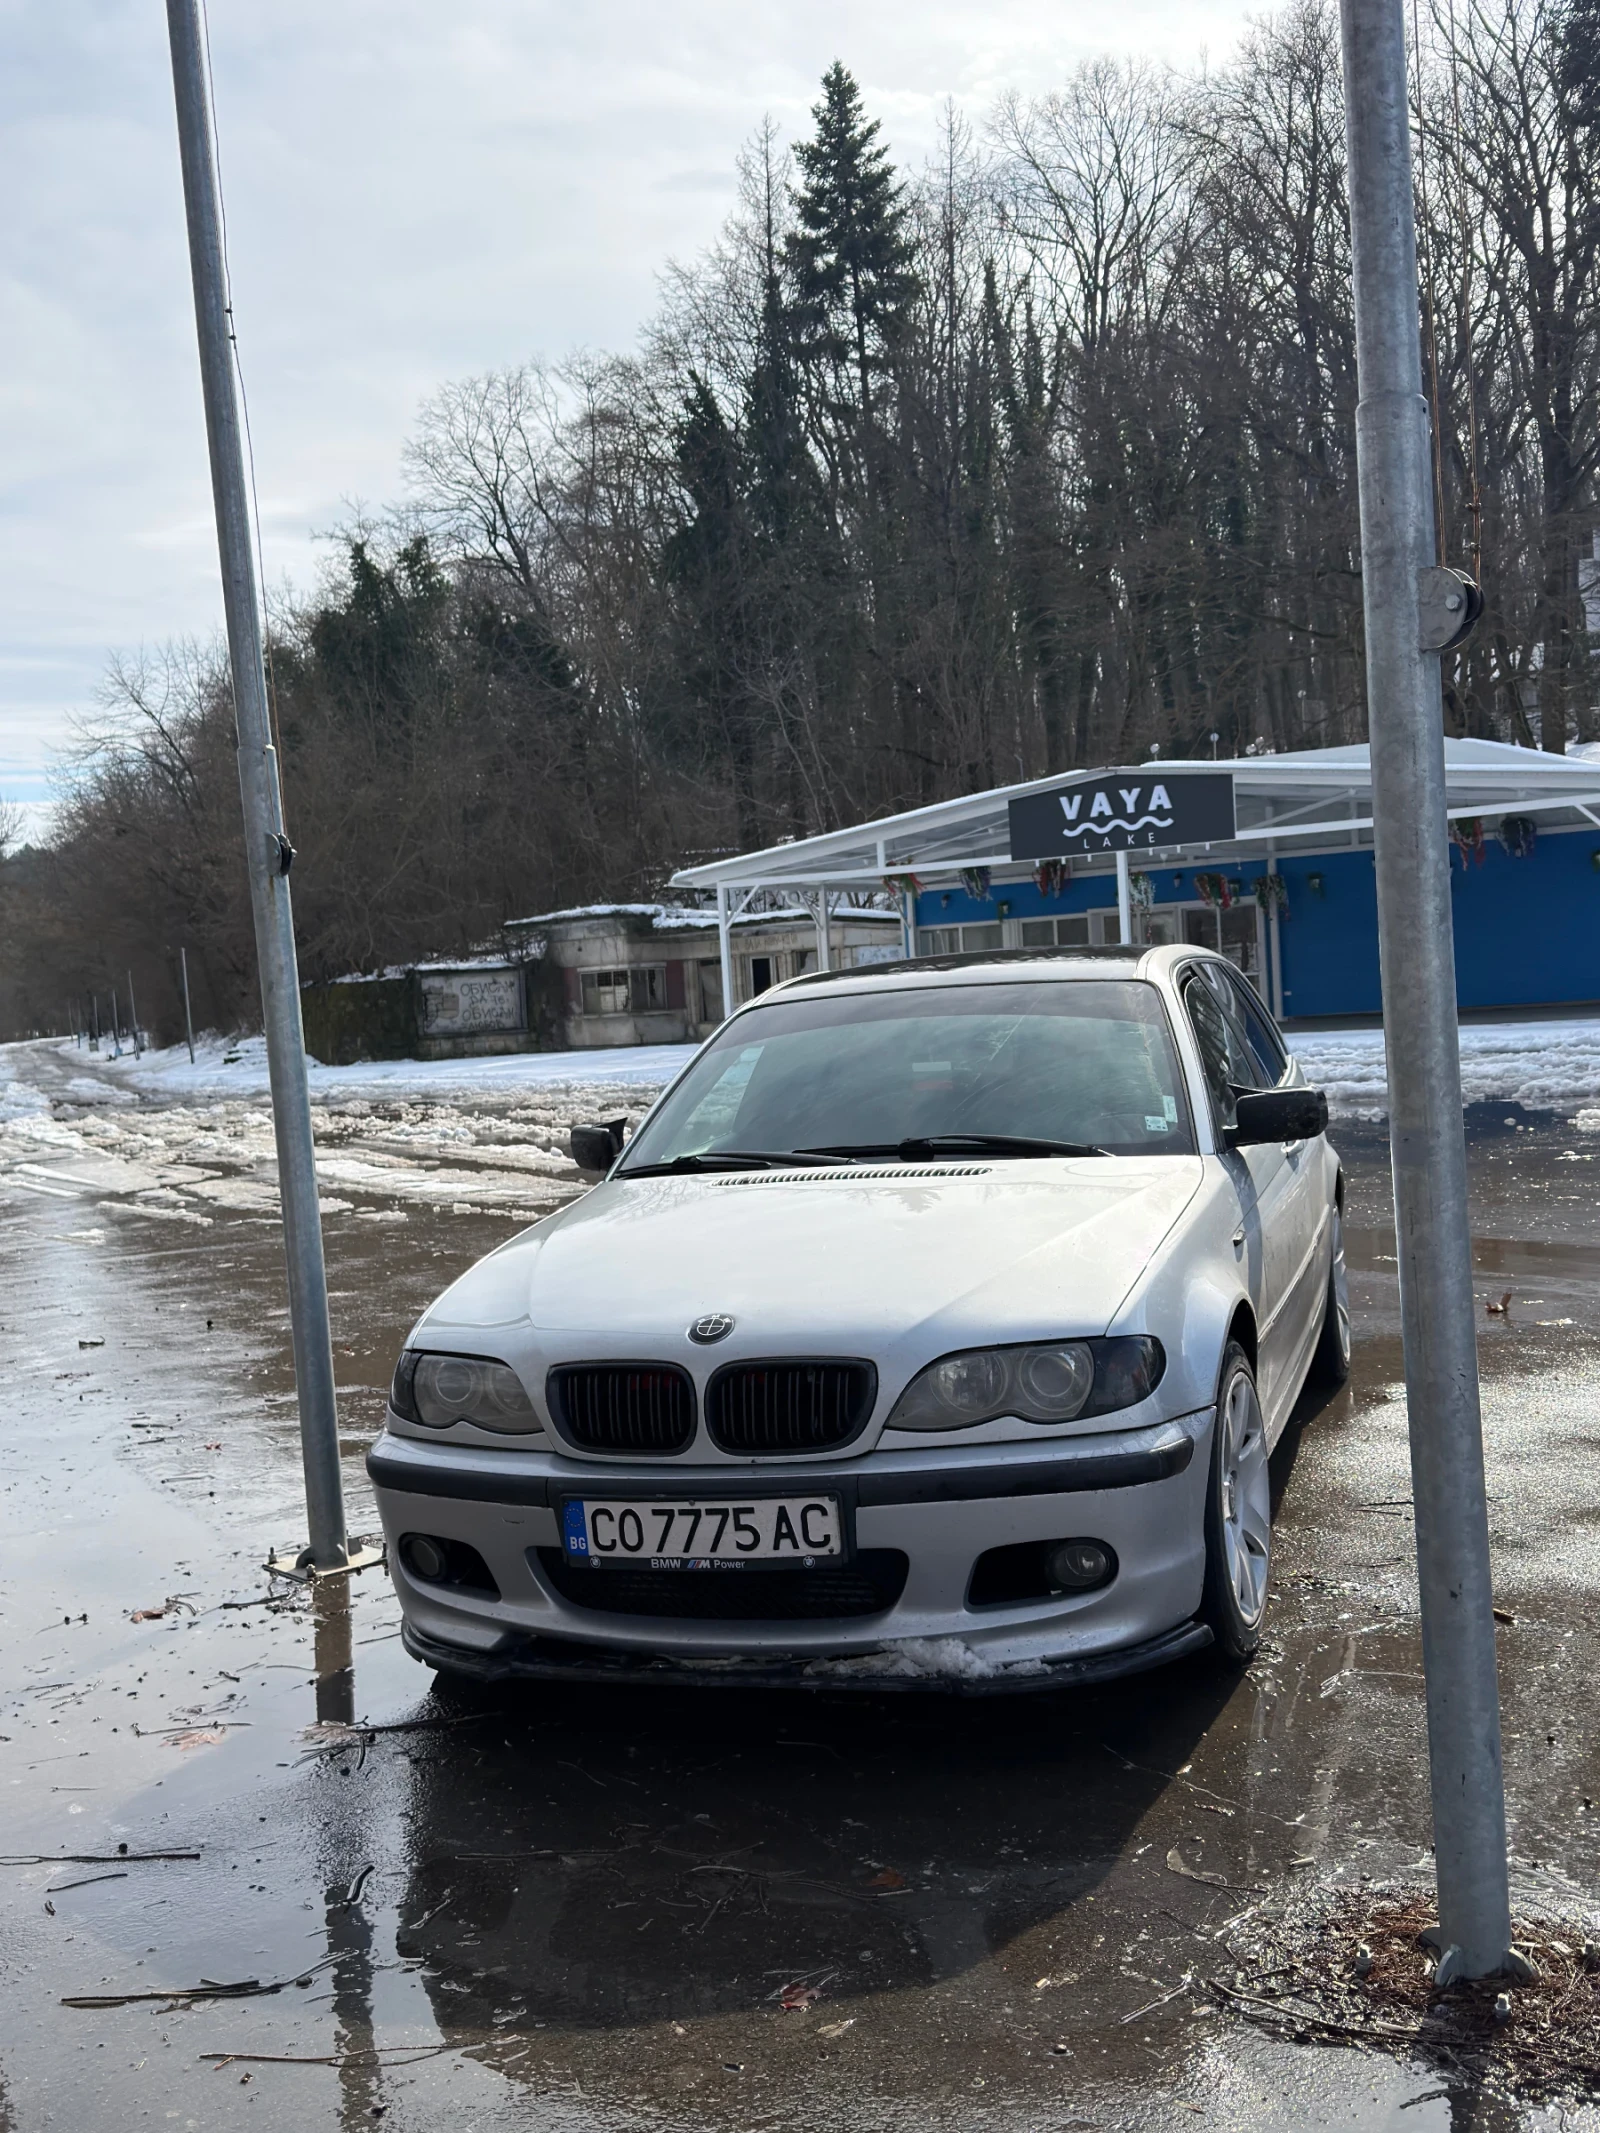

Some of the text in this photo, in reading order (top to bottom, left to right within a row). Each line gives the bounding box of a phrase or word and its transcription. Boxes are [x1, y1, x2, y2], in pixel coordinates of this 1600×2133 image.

[1059, 785, 1172, 820] VAYA
[1083, 832, 1155, 849] LAKE
[651, 1507, 761, 1553] 7775
[773, 1503, 831, 1550] AC
[570, 1536, 587, 1550] BG
[651, 1558, 681, 1569] BMW
[714, 1559, 746, 1569] Power
